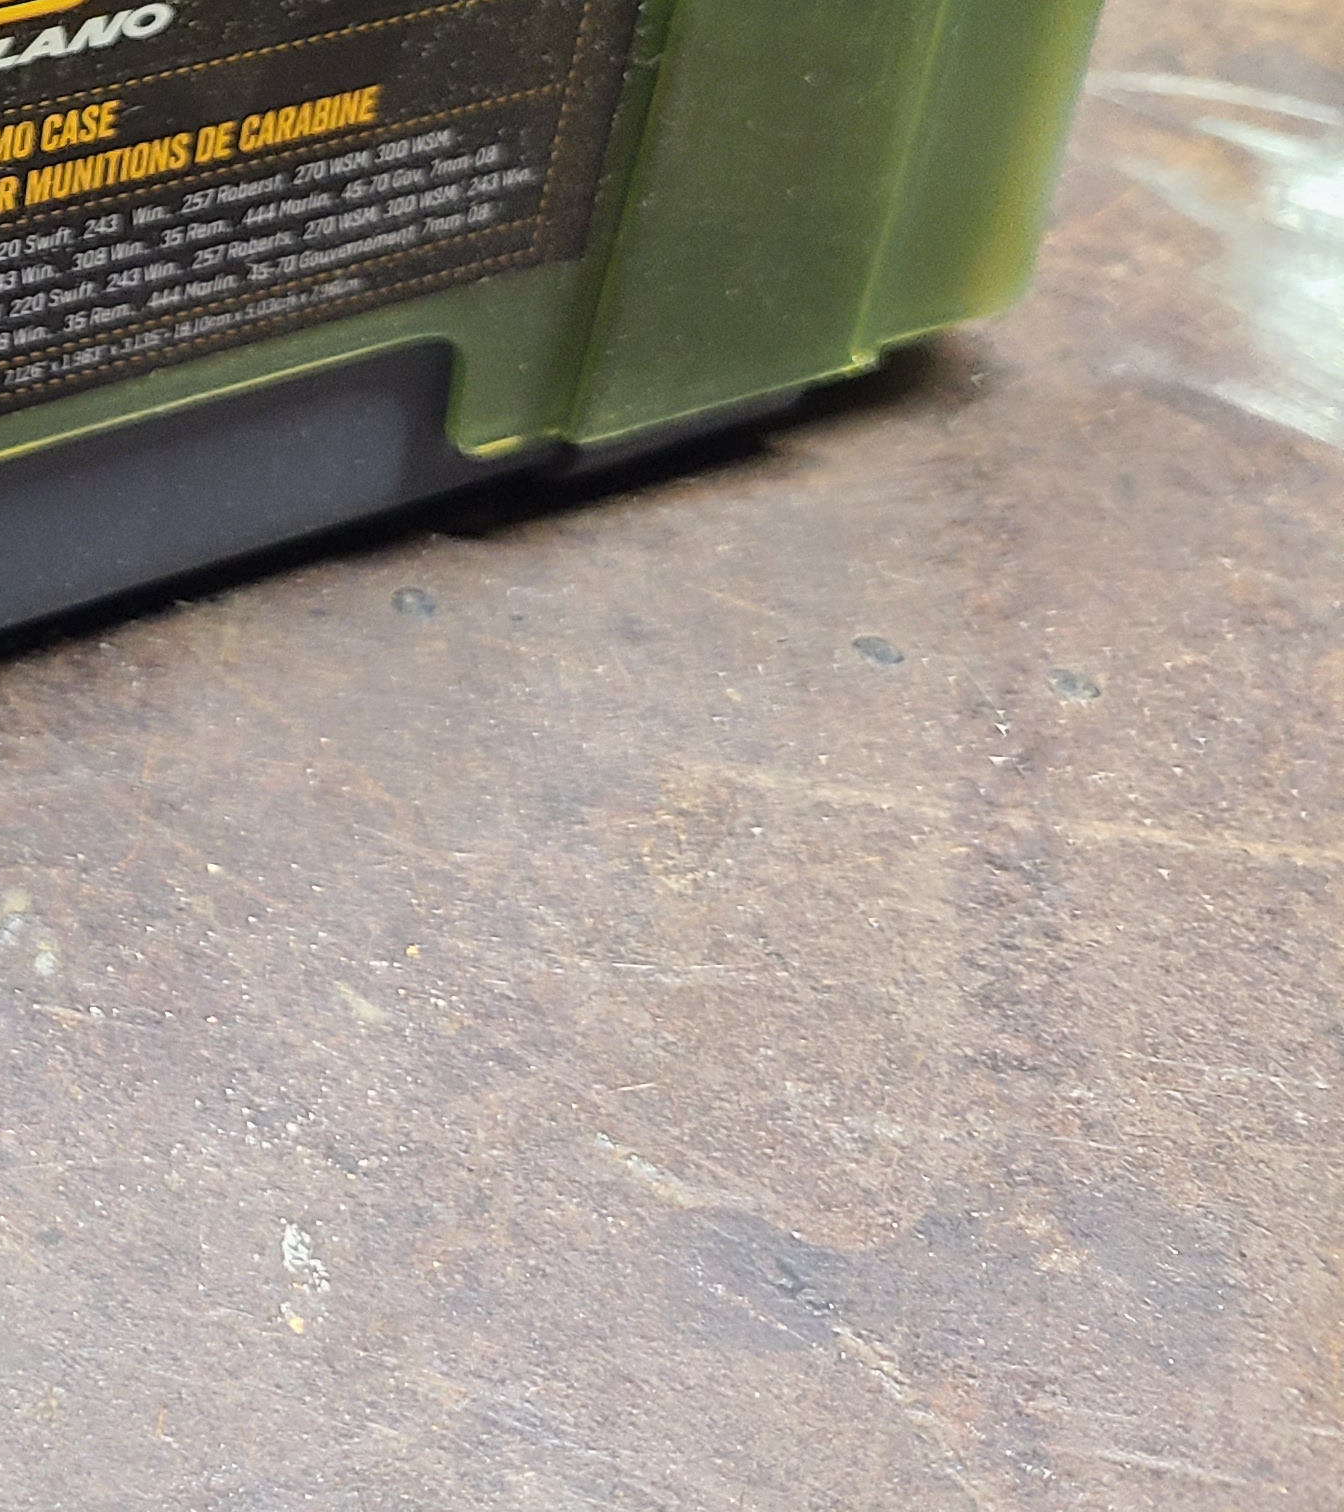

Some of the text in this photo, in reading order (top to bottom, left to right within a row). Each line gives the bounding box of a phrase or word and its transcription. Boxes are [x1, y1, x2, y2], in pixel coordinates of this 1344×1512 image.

[23, 131, 193, 206] MUNITIONS
[194, 121, 234, 164] DE
[238, 85, 379, 154] CARABINE
[40, 99, 122, 153] CASE
